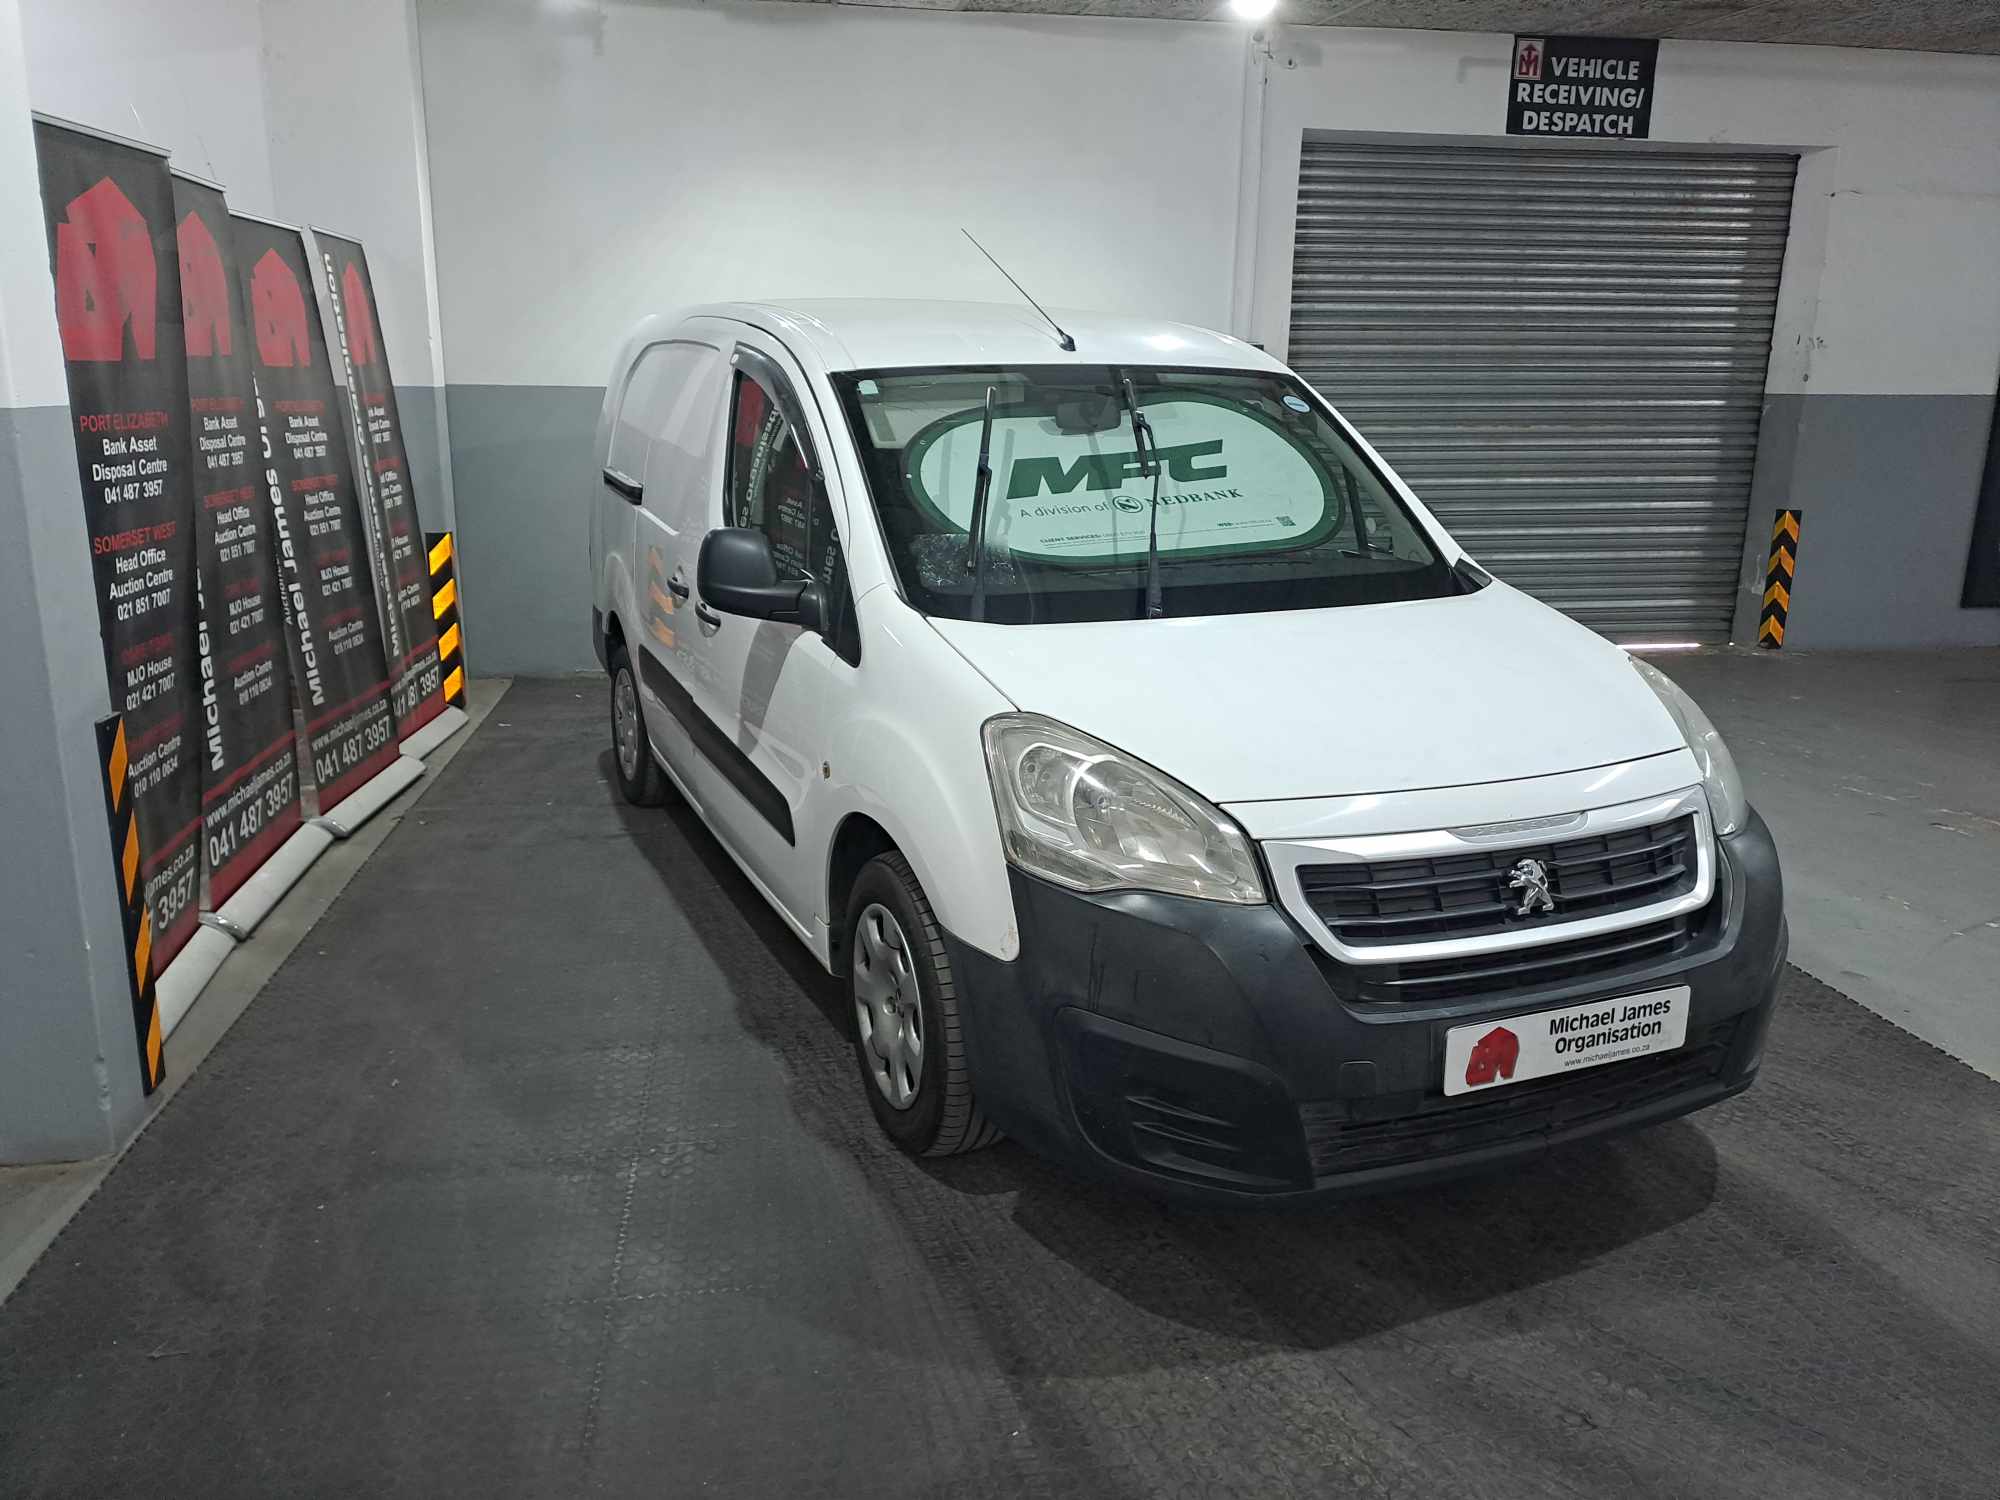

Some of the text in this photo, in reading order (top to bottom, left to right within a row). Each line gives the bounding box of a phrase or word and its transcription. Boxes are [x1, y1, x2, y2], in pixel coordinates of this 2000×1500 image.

[1551, 57, 1640, 81] VEHICLE
[1516, 82, 1645, 109] RECEIVING/
[1522, 110, 1634, 135] DESPATCH
[79, 414, 111, 432] PORT
[103, 436, 158, 456] Bank Asset
[92, 458, 168, 483] Disposal Centre
[1006, 439, 1228, 499] MFC
[104, 479, 164, 504] 041 487 3957
[1019, 488, 1244, 519] A division of NEDBANK
[94, 527, 150, 554] SOMERSET
[115, 548, 166, 574] Head Office
[109, 568, 173, 600] Auction Centre
[266, 468, 325, 706] Michael James
[117, 588, 172, 621] 021 851 7007
[127, 656, 173, 688] MJO House
[419, 665, 439, 698] 3957
[126, 693, 141, 711] 021
[158, 672, 175, 694] 7007
[198, 621, 225, 772] Michael
[128, 751, 157, 779] Auction
[316, 715, 391, 784] 041 487 3957
[209, 771, 294, 867] 041 487 3957
[1549, 998, 1672, 1037] Michael James
[1554, 1020, 1662, 1055] Organisation
[1563, 1043, 1651, 1068] www.michaeljames.co.za
